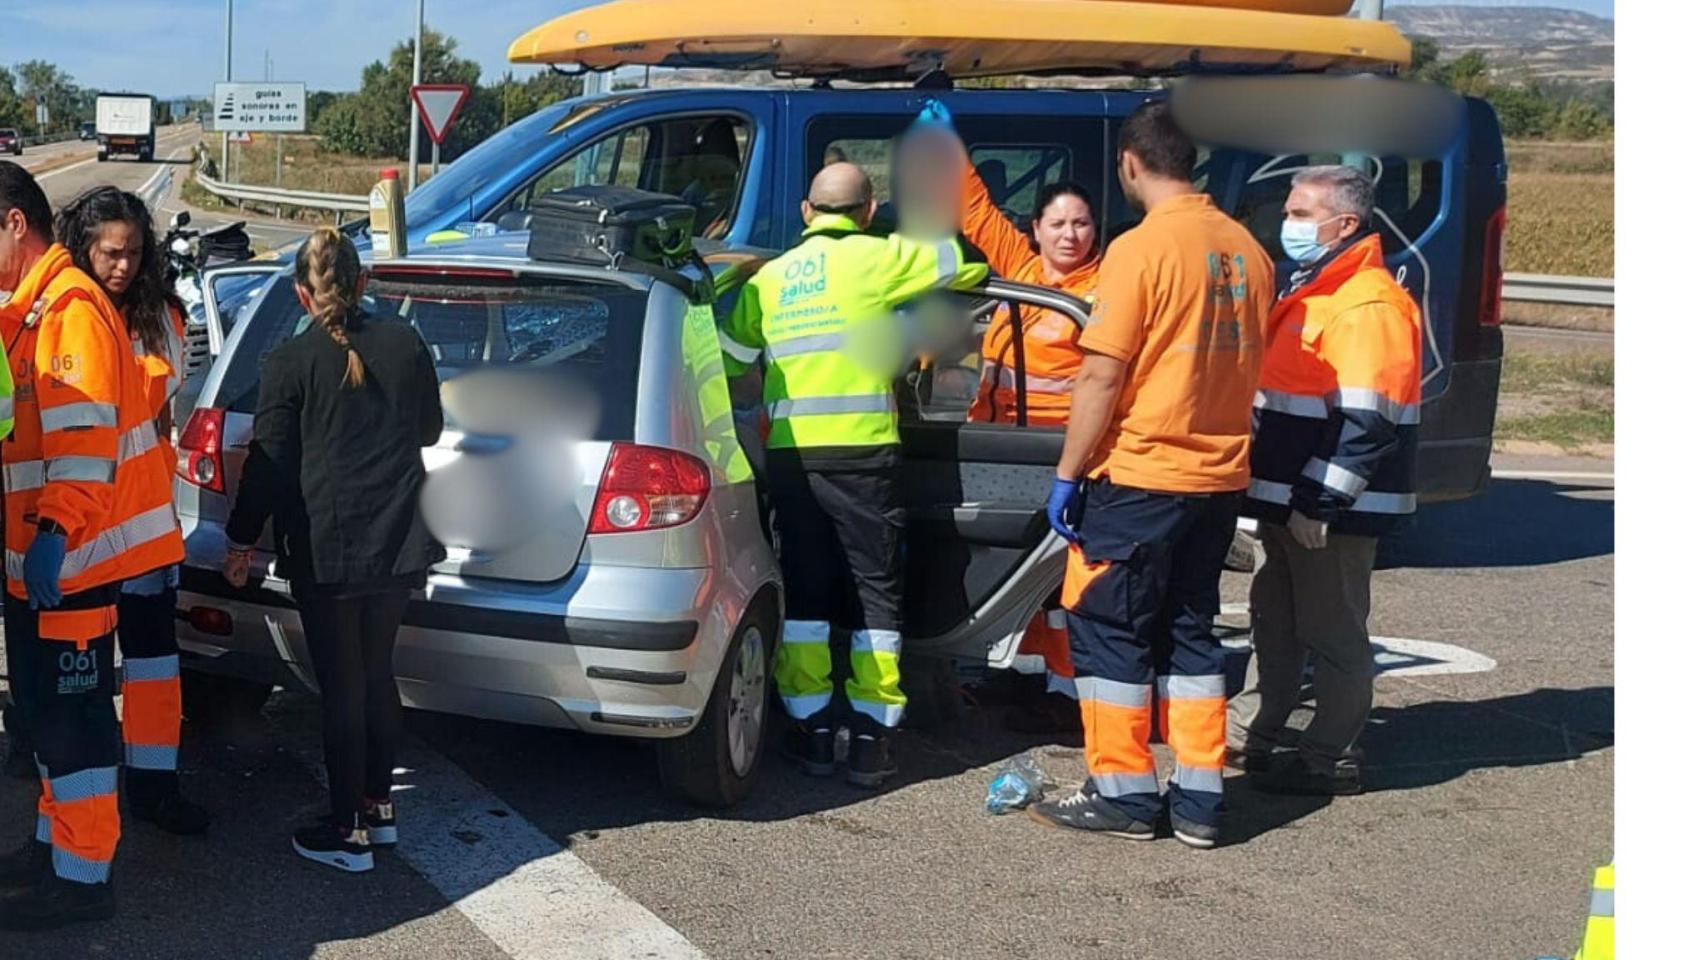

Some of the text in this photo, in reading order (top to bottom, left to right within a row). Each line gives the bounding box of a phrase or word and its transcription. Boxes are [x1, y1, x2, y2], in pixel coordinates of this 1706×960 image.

[239, 112, 254, 123] eje
[268, 112, 298, 122] borde
[784, 252, 826, 280] 061
[1207, 252, 1245, 279] 061
[779, 274, 826, 300] salud
[58, 649, 97, 672] 061
[57, 669, 98, 689] salud
